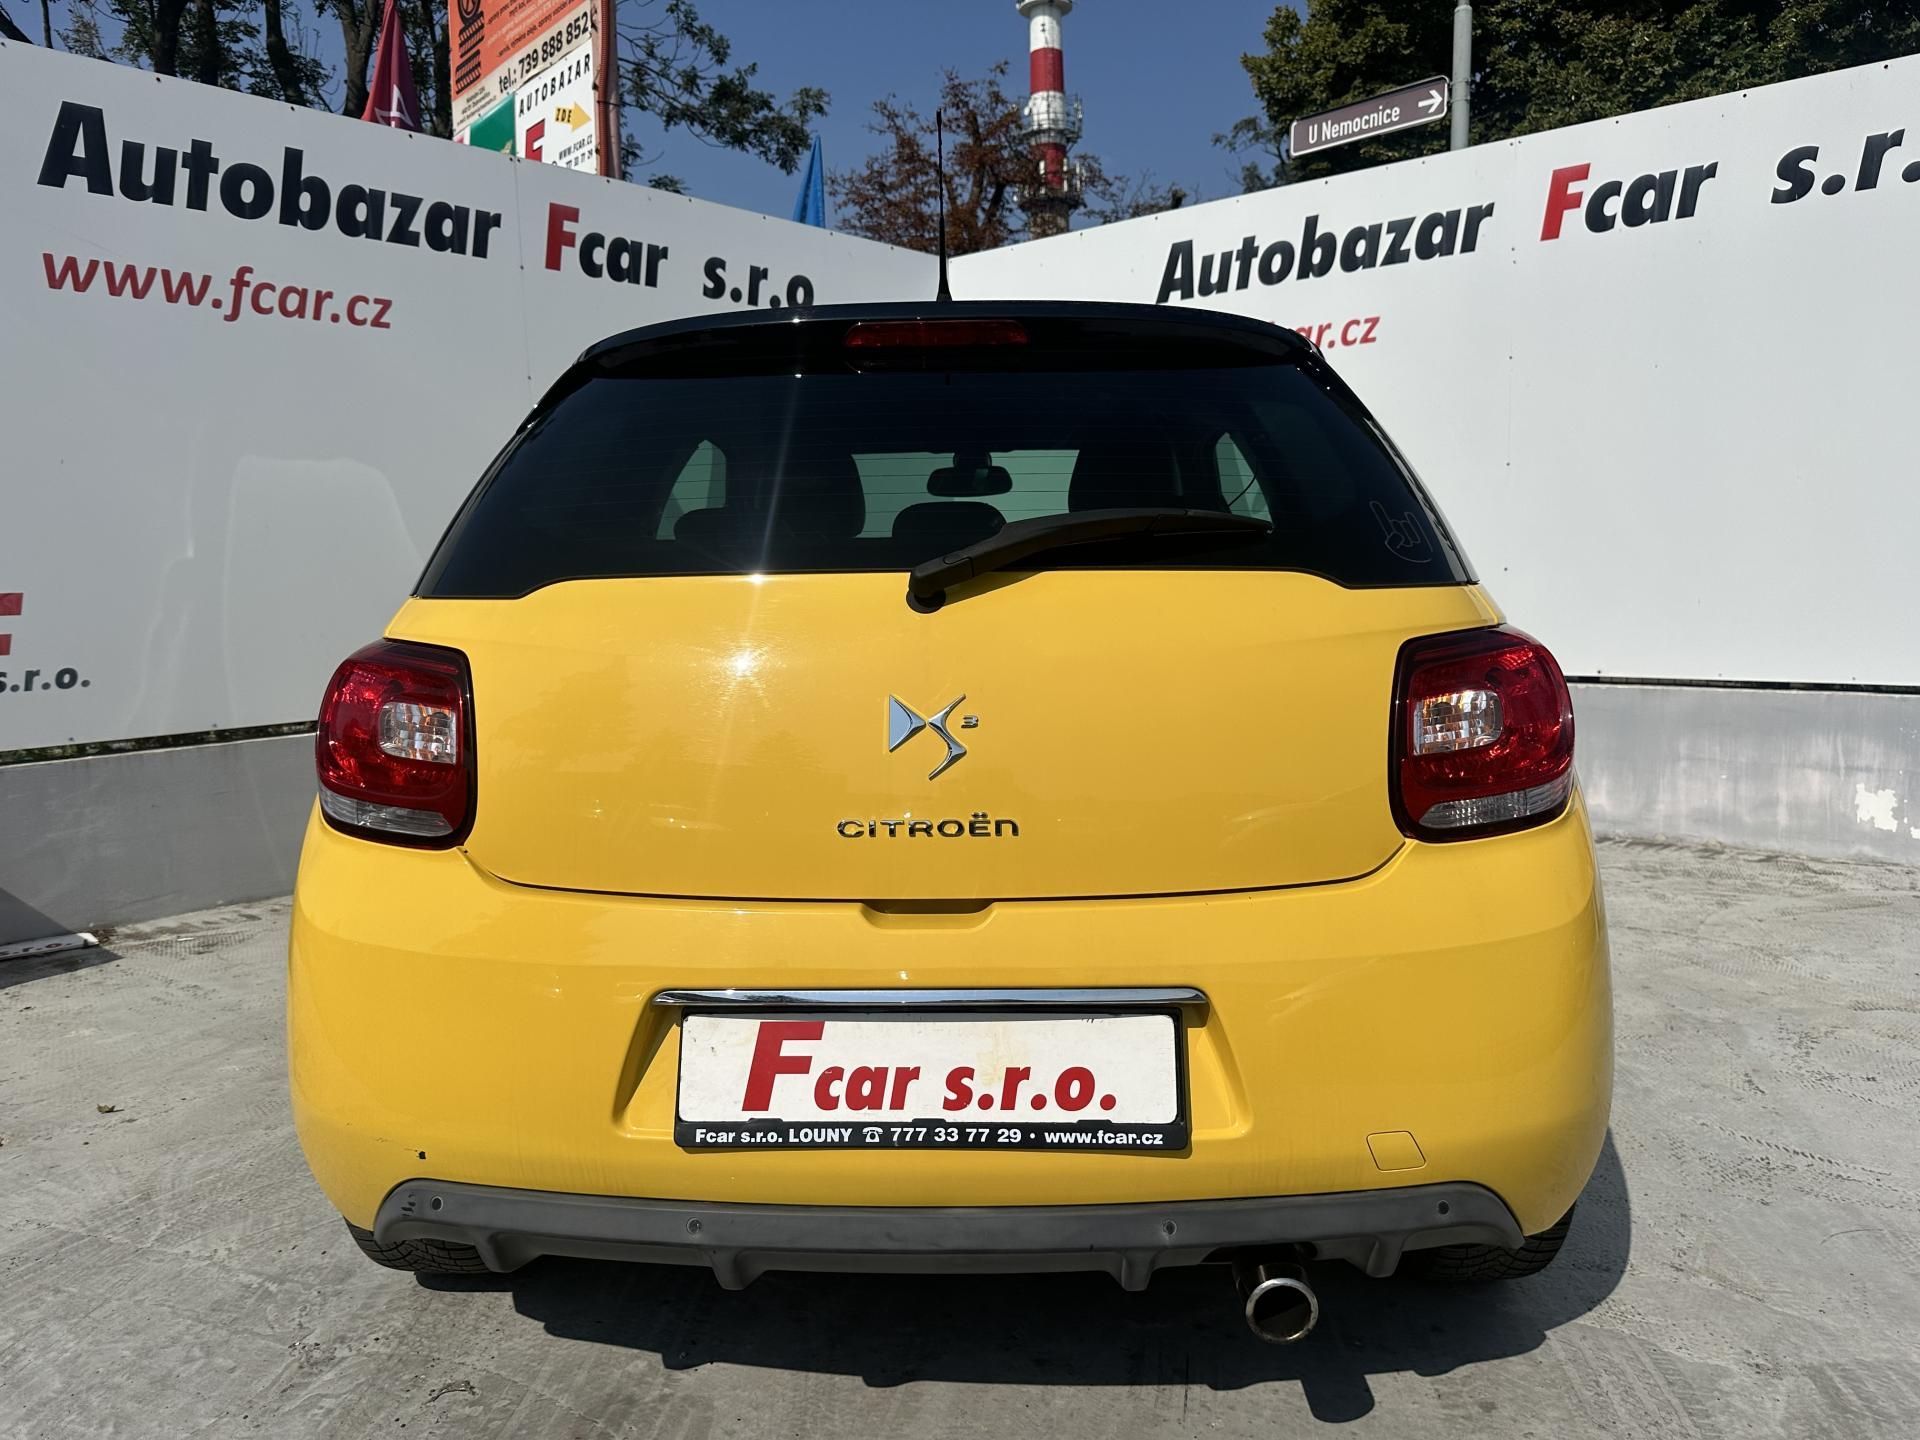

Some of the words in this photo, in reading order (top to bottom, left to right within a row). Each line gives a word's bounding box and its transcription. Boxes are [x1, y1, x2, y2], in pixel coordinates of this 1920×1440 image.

[518, 48, 539, 79] 739
[541, 30, 563, 64] 888
[565, 10, 589, 45] 852
[518, 53, 591, 118] AUTOBAZAR
[555, 107, 572, 123] ZDE
[1309, 124, 1318, 144] U
[1322, 105, 1400, 141] Nemocnice
[37, 100, 502, 259] Autobazar
[1540, 161, 1719, 242] Fcar
[545, 202, 669, 288] Fcar
[1156, 202, 1495, 304] Autobazar
[42, 252, 393, 329] www.fcar.cz
[741, 1020, 920, 1112] Fcar
[942, 1065, 1118, 1112] s.r.o.
[695, 1128, 736, 1144] Fcar
[740, 1130, 783, 1144] s.r.o.
[788, 1128, 853, 1143] LOUNY
[890, 1127, 929, 1143] 777
[934, 1127, 959, 1143] 33
[965, 1128, 988, 1143] 77
[997, 1128, 1023, 1143] 29
[1044, 1129, 1164, 1145] www.fcar.cz
